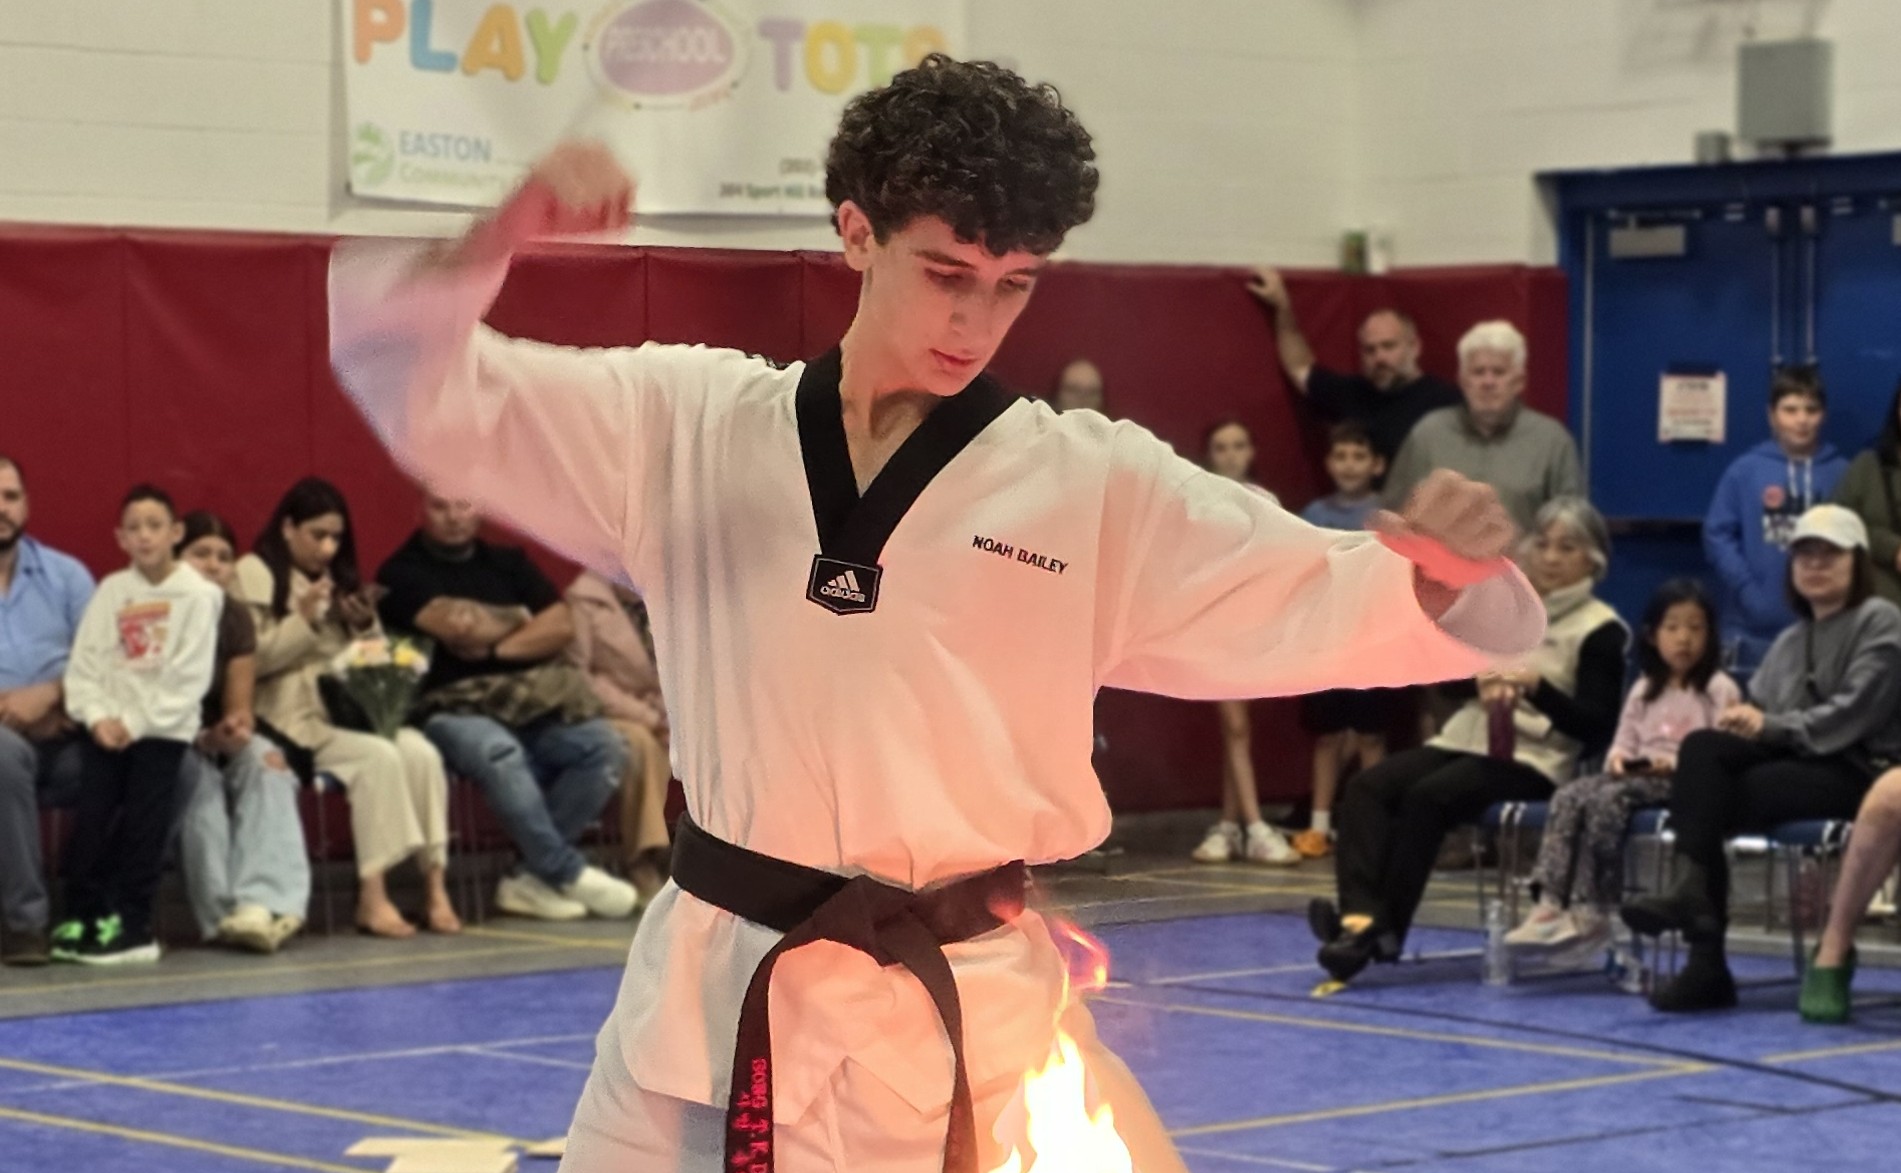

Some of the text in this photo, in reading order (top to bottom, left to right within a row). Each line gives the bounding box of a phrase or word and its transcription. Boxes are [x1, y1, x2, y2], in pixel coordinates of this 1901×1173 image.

[353, 0, 577, 85] PLAY
[399, 130, 492, 163] EASTON
[972, 535, 1069, 574] NOAH BAILEY
[820, 585, 866, 603] adidas
